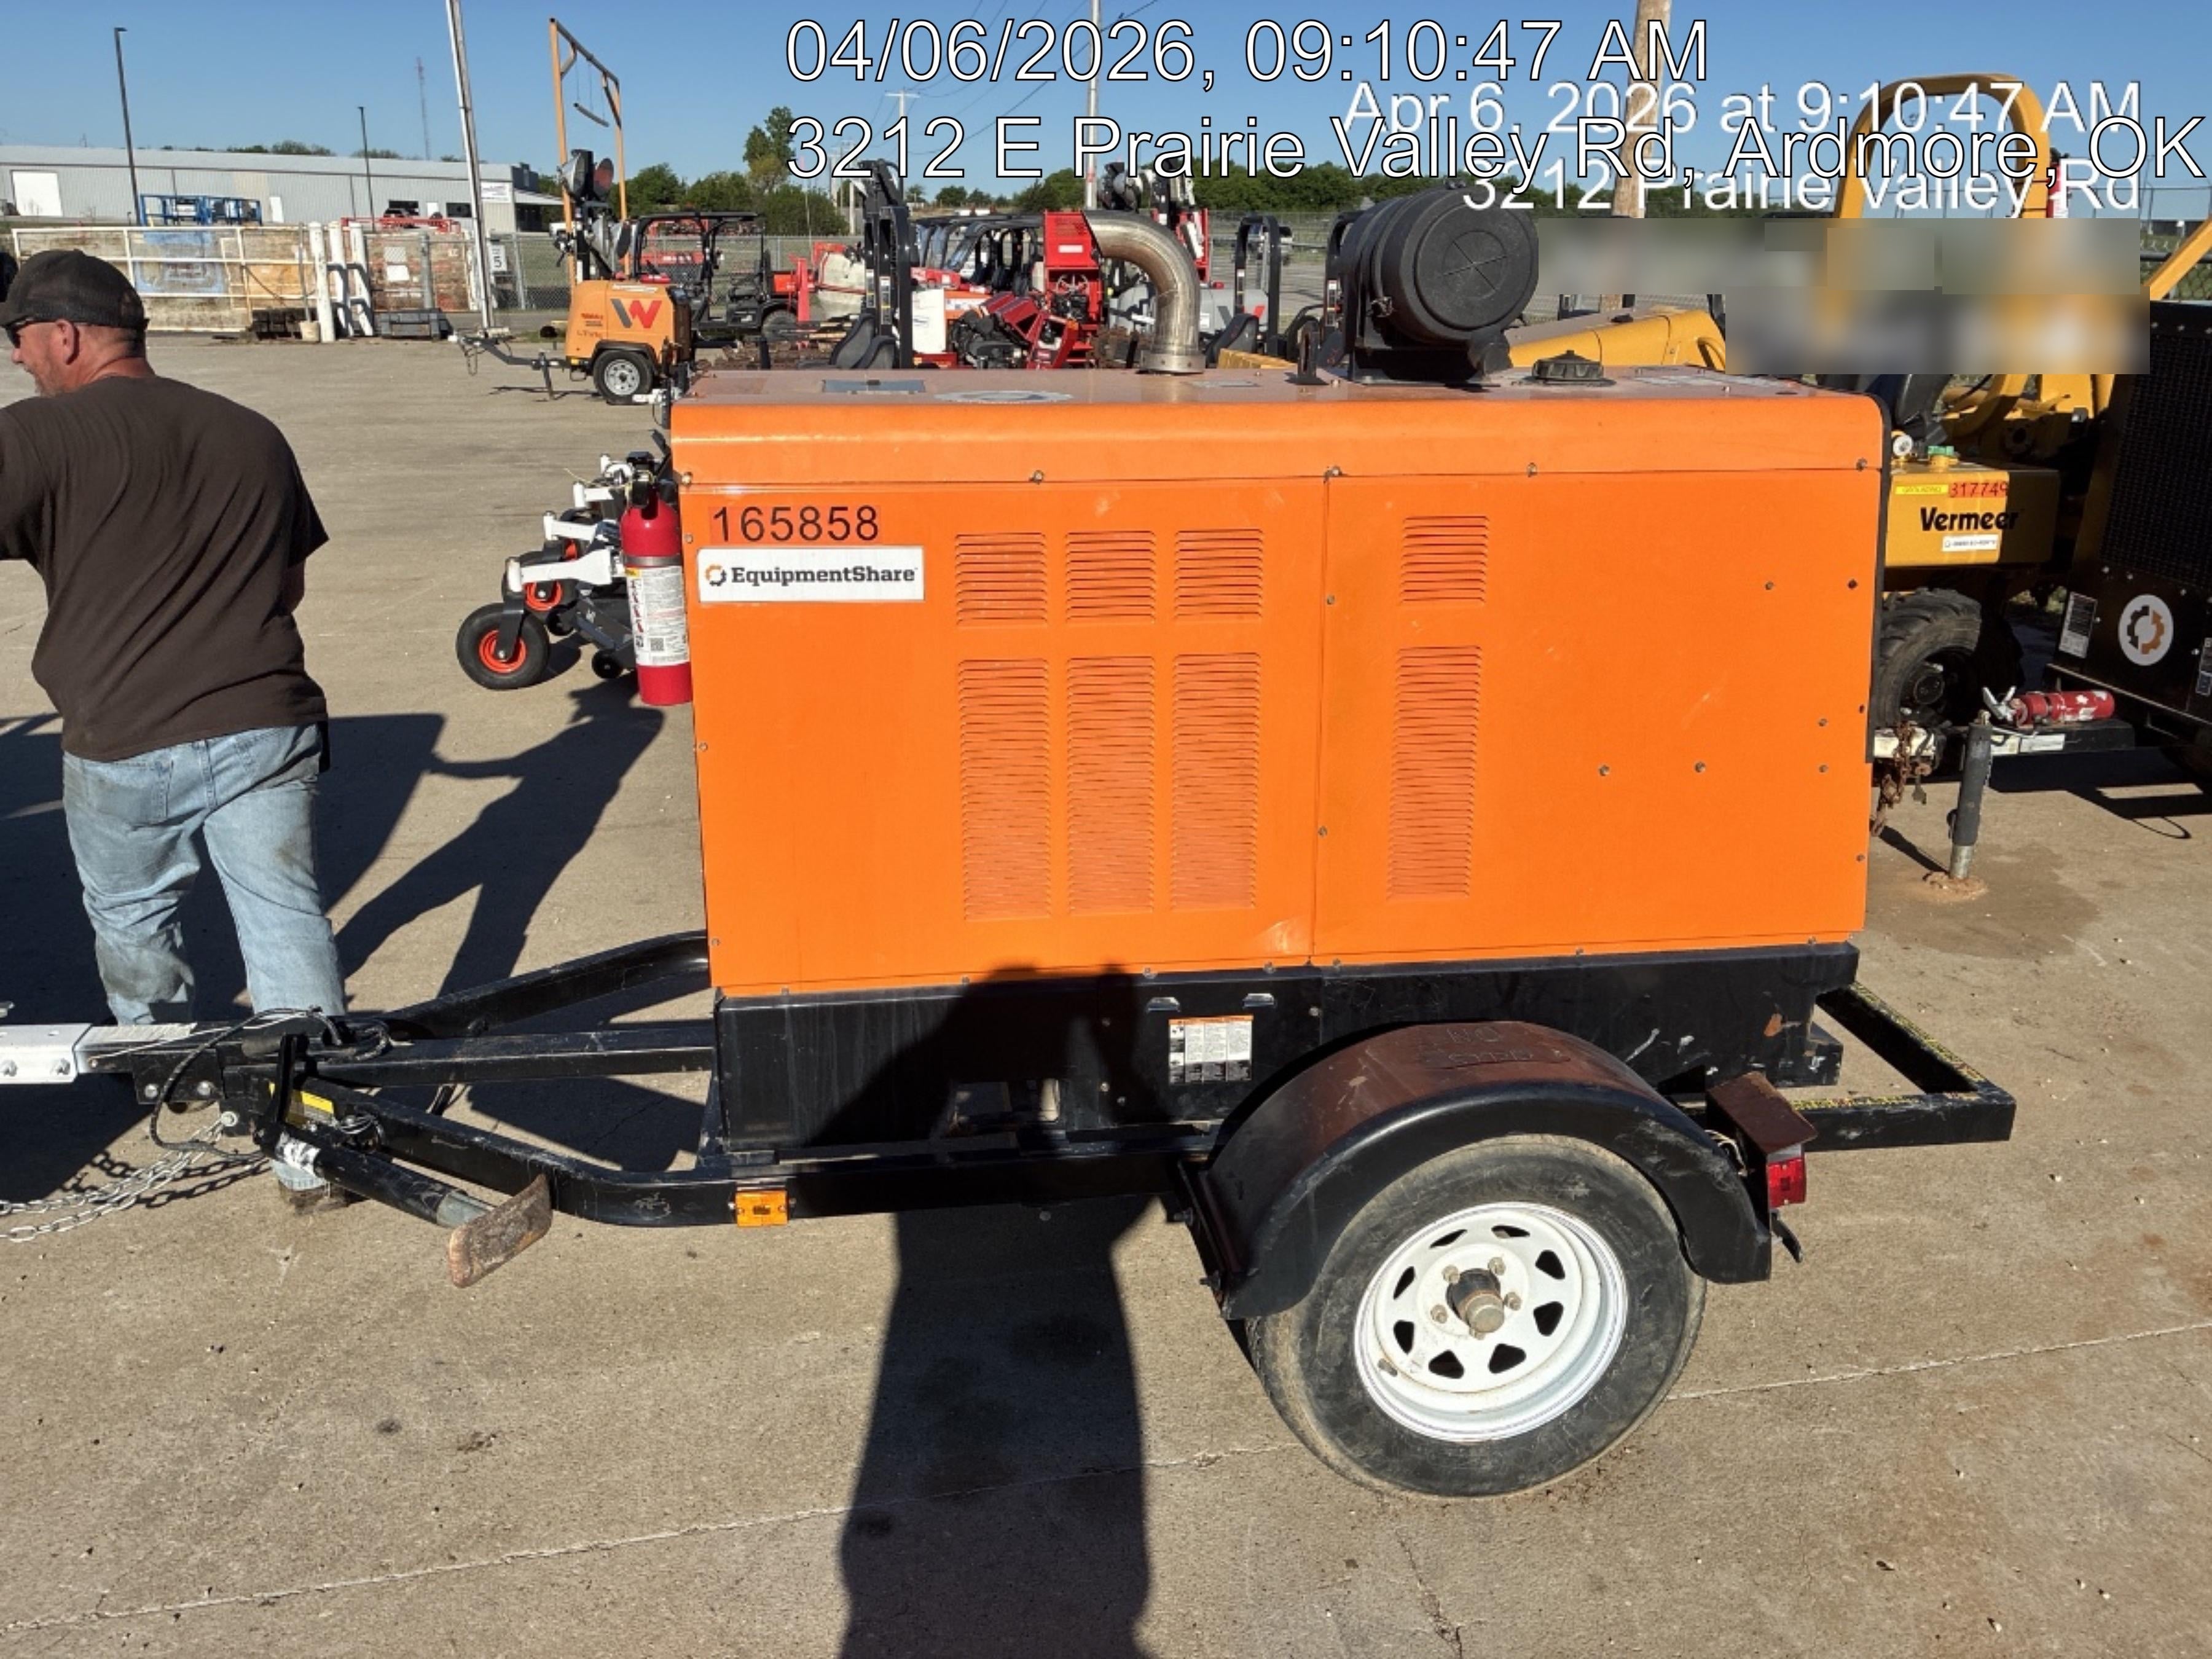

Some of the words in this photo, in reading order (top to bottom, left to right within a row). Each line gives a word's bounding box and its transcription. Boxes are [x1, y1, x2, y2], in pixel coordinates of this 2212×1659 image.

[1949, 480, 2008, 498] 317749
[713, 506, 879, 541] 165858
[1920, 506, 2020, 531] Vermeer
[731, 566, 916, 586] EquipmentShare
